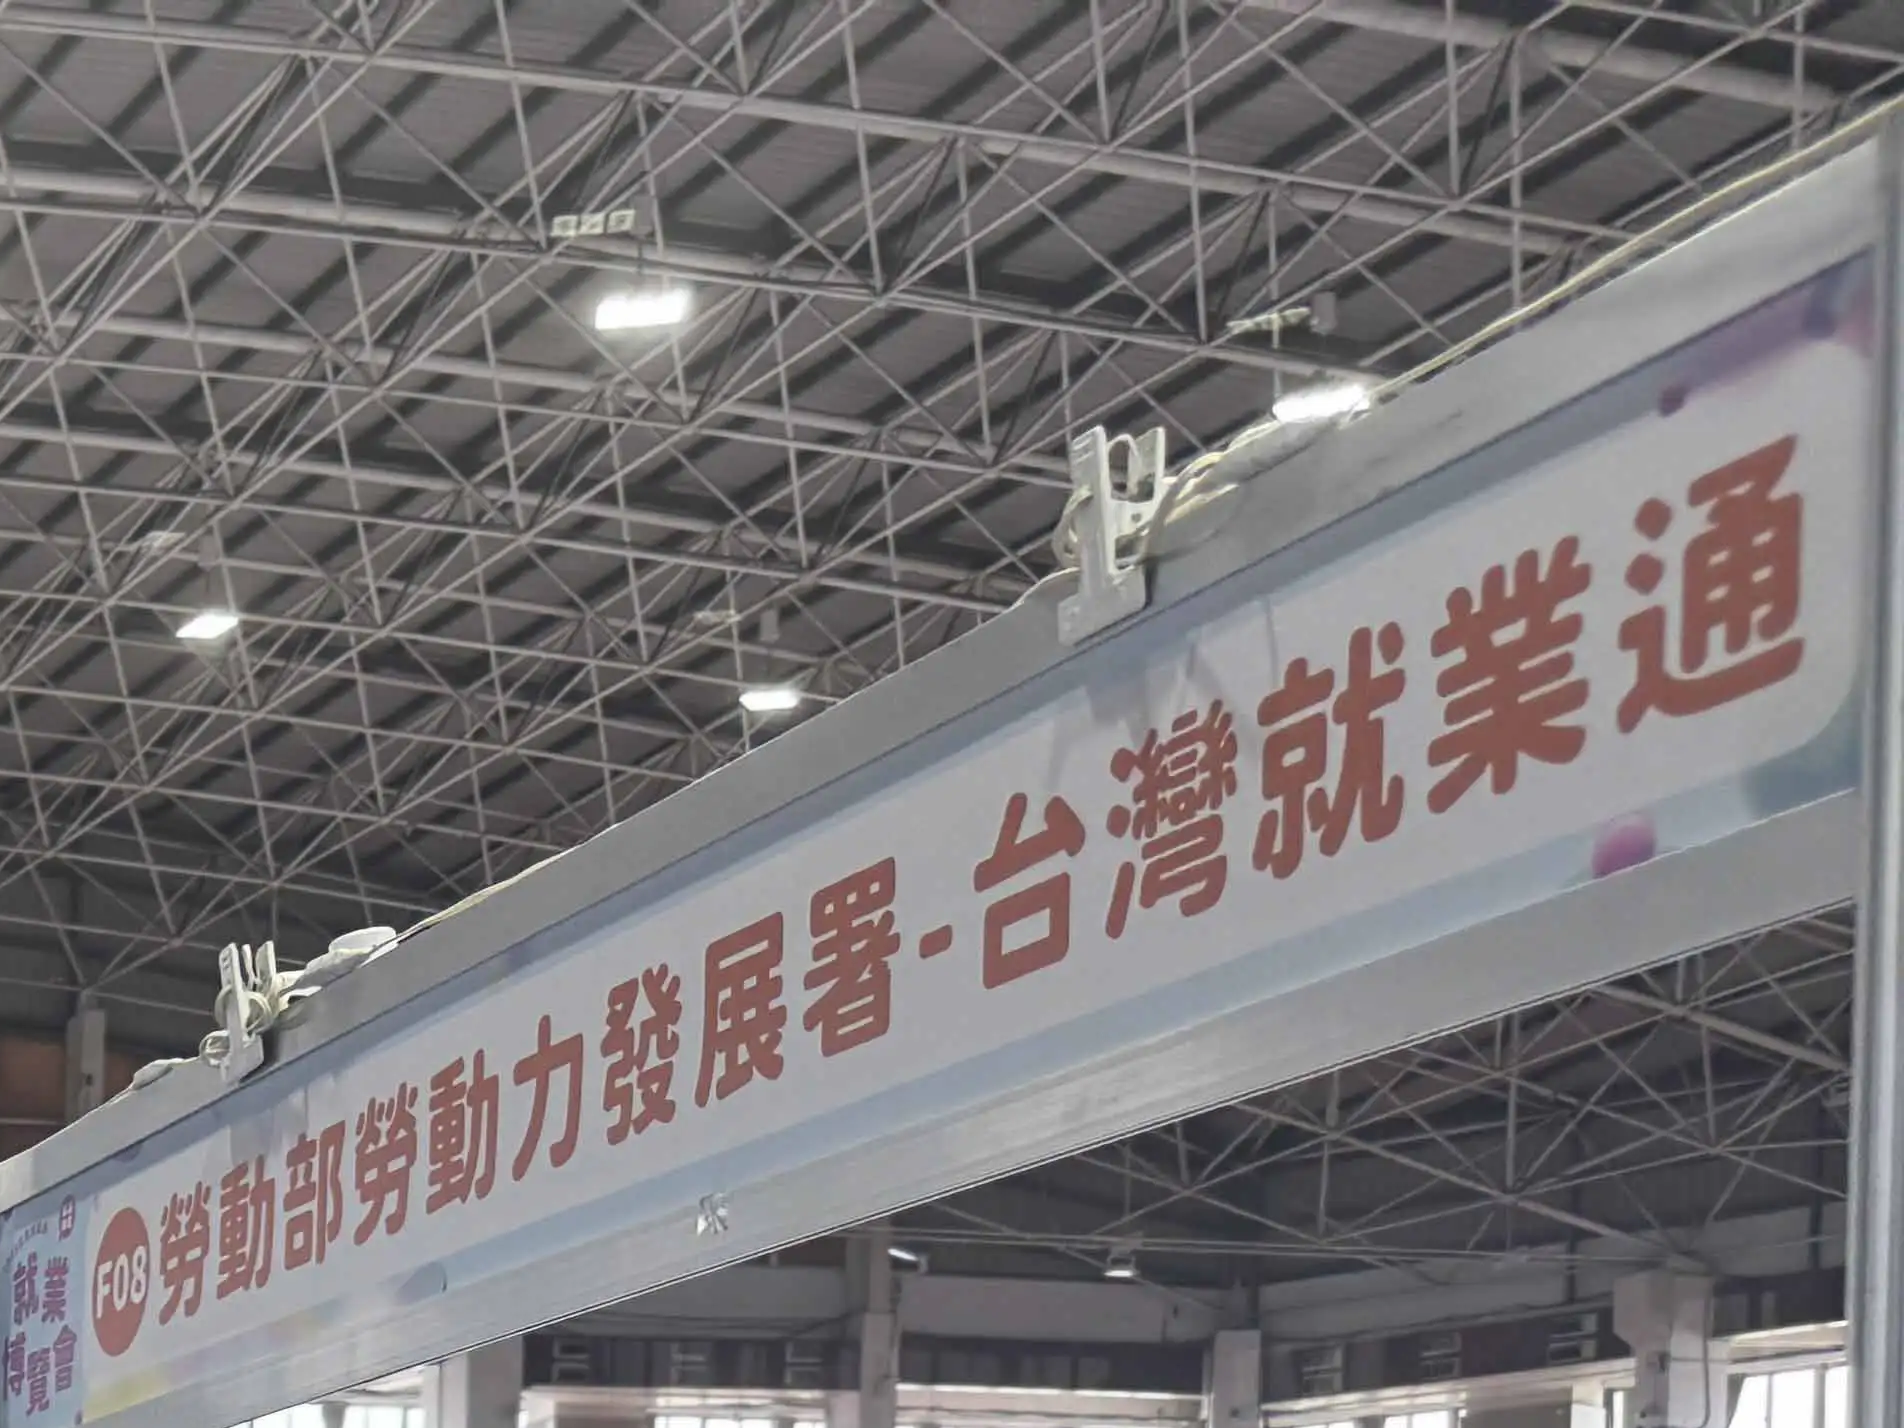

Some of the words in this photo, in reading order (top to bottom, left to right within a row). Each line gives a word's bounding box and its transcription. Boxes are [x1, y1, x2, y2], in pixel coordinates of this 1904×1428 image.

[157, 433, 1805, 1326] 勞動部勞動力發展署-台灣就業通
[95, 1245, 148, 1320] F08
